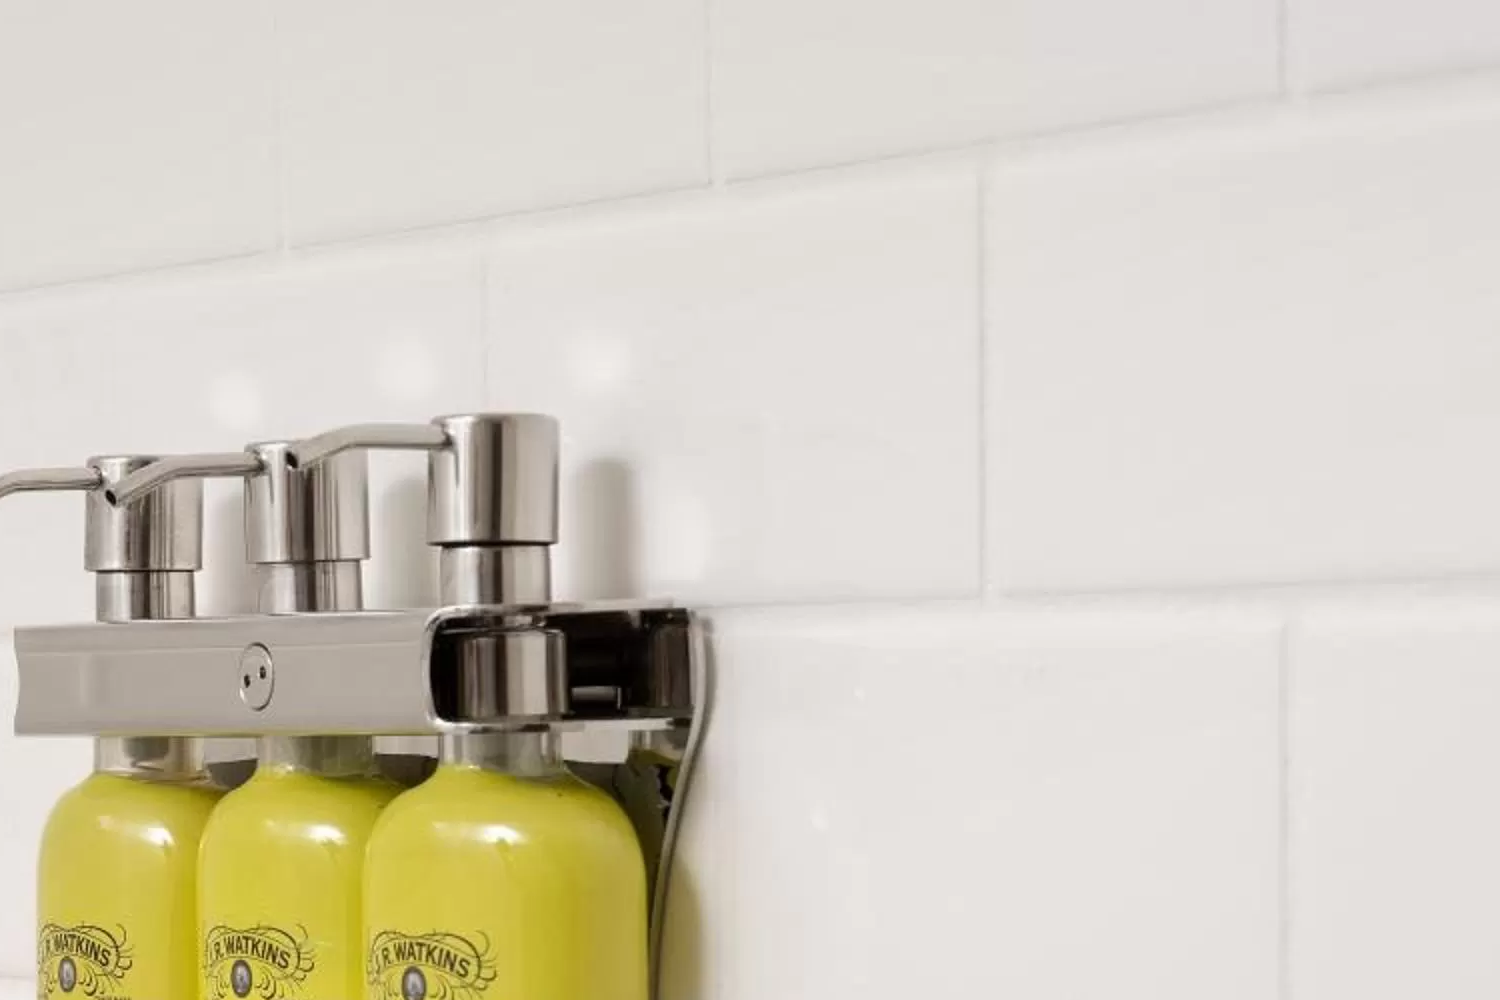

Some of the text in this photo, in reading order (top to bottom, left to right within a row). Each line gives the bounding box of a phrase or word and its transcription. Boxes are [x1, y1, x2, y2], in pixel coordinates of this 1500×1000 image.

[53, 933, 110, 967] WATKINS
[224, 935, 291, 969] WATKINS
[394, 940, 471, 978] WATKINS
